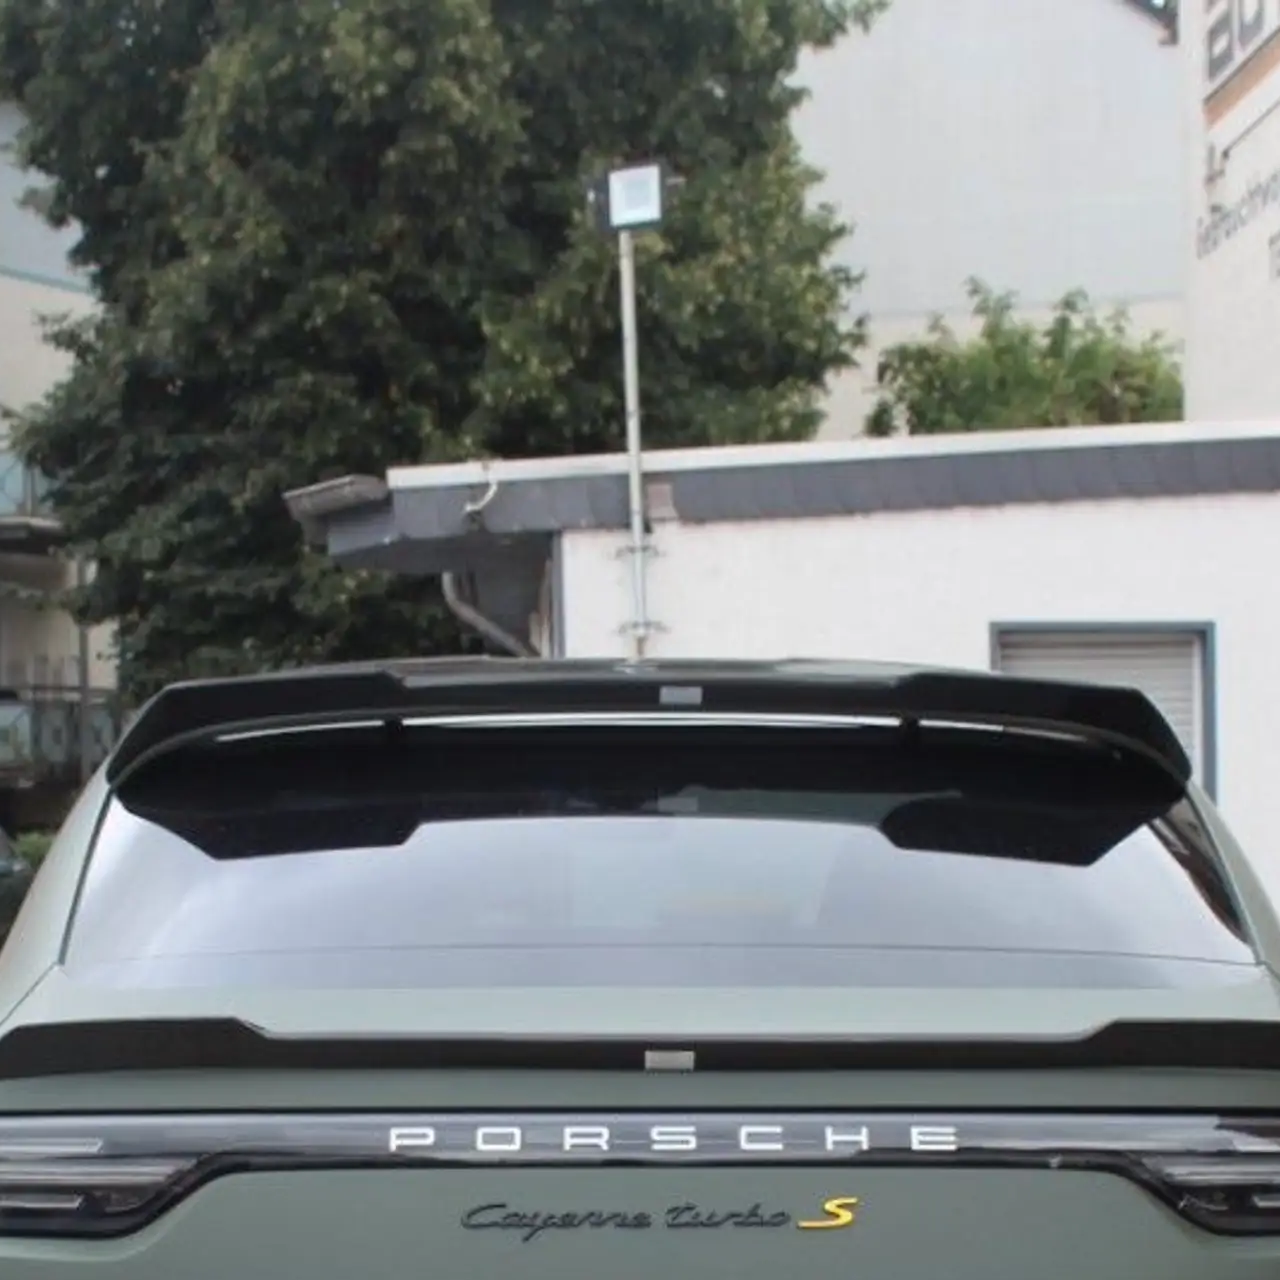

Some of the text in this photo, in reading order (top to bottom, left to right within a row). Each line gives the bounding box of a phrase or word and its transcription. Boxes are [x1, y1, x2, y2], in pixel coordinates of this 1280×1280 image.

[388, 1126, 958, 1152] PORSCHE
[459, 1197, 860, 1243] Cayenne turbo S
